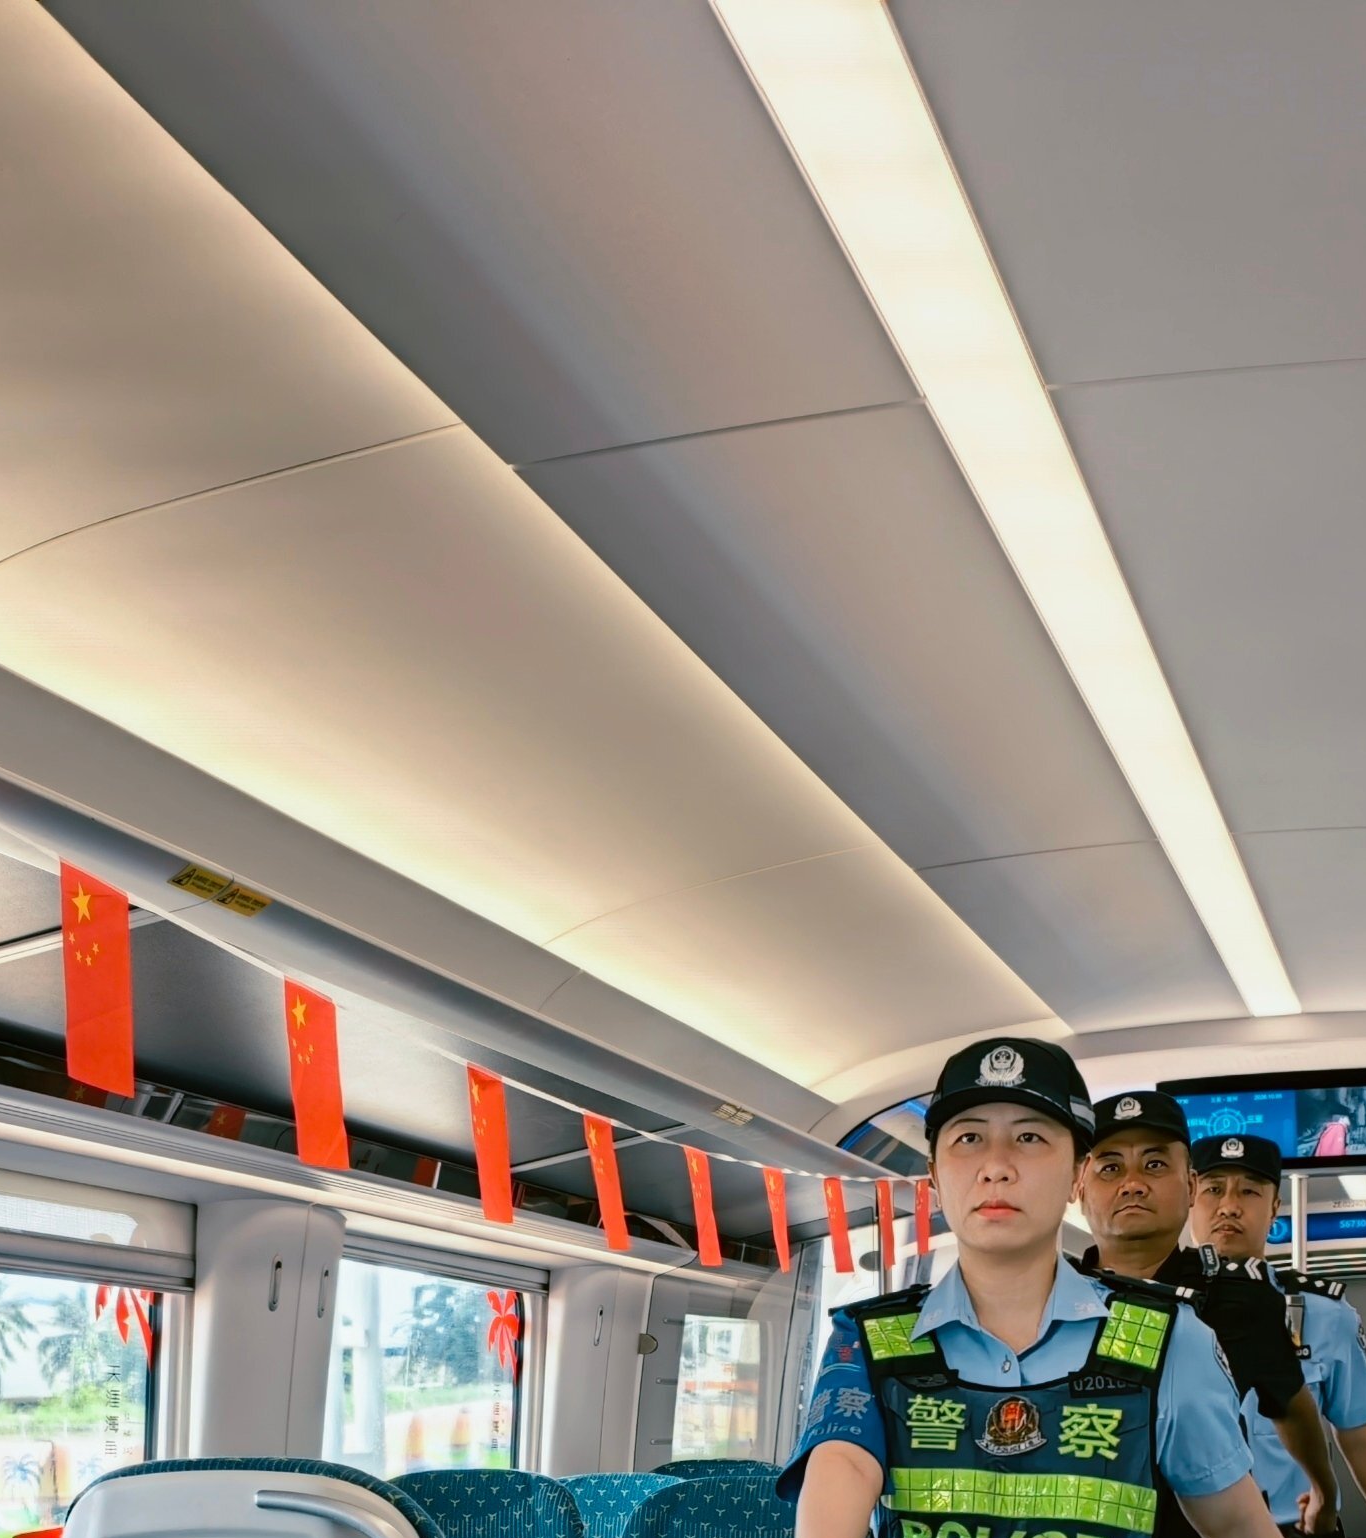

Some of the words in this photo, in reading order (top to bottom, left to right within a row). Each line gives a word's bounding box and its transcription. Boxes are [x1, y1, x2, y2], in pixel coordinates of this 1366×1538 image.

[1073, 1375, 1139, 1392] 0201
[906, 1394, 967, 1451] 警
[1057, 1403, 1123, 1461] 察
